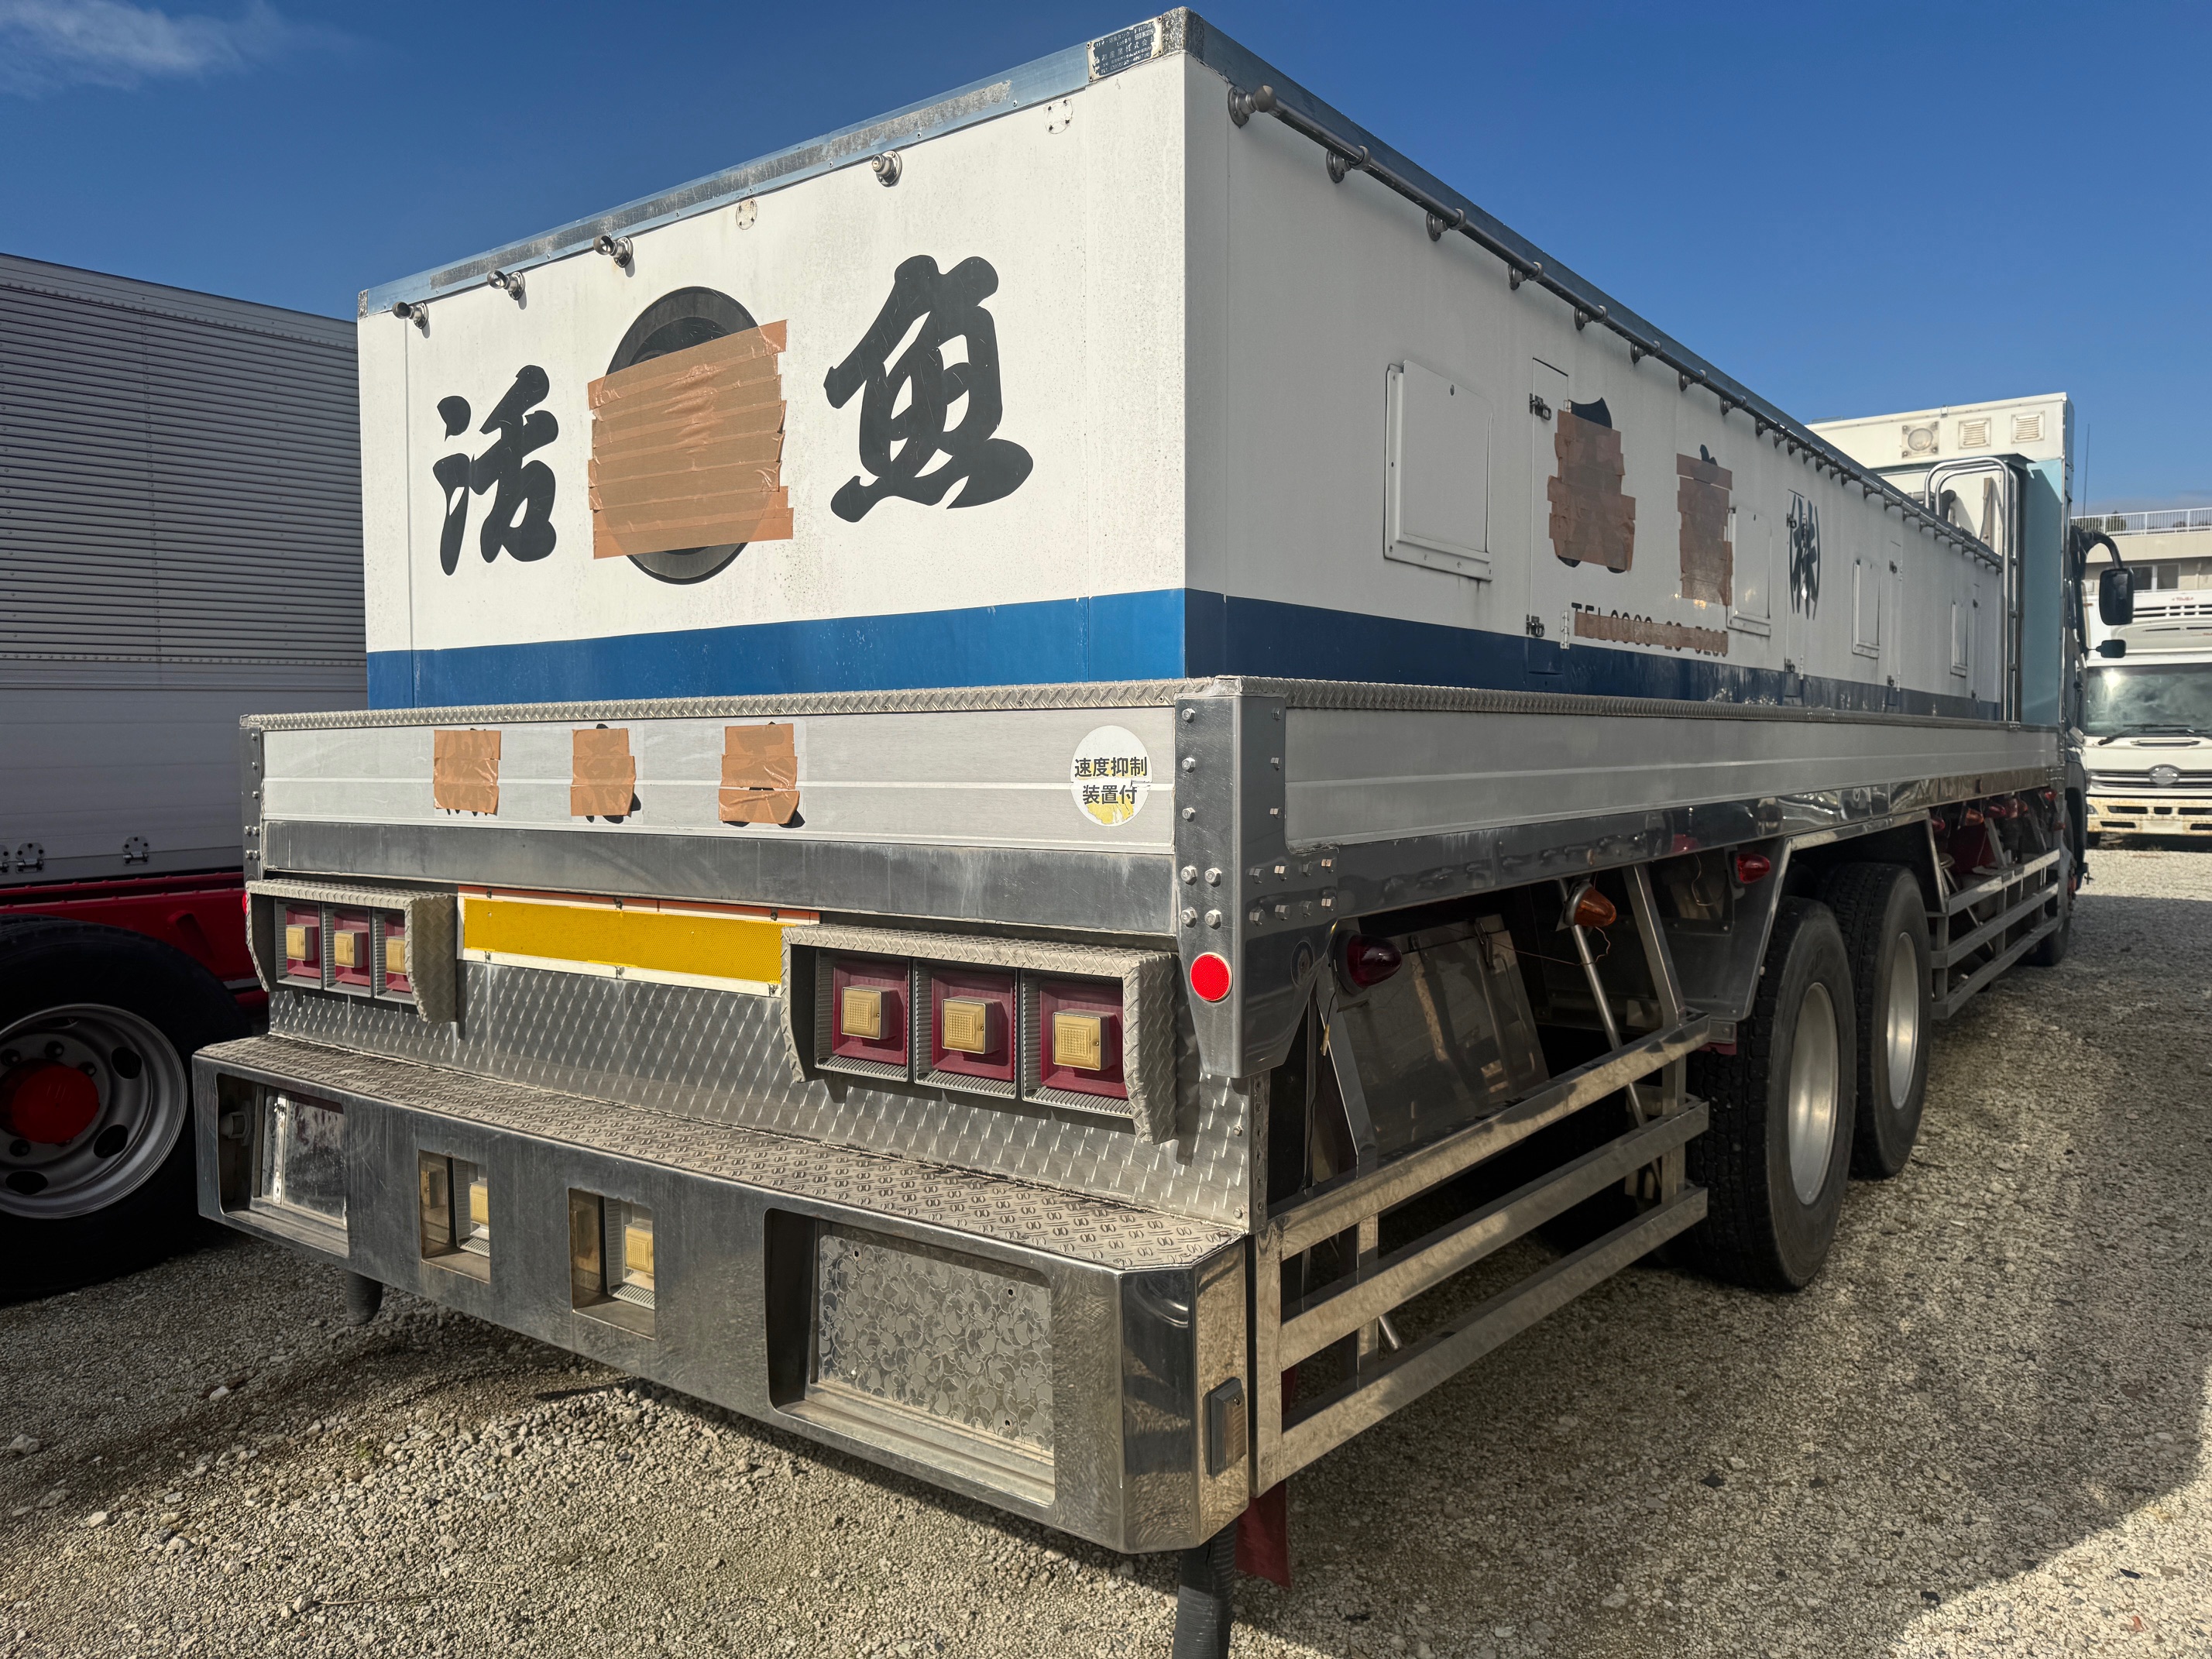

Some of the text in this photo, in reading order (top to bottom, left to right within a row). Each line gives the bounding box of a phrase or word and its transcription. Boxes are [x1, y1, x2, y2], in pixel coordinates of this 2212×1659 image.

[433, 254, 1034, 575] 活 魚
[1074, 756, 1148, 778] 速度抑制
[1082, 785, 1138, 805] 装置付
